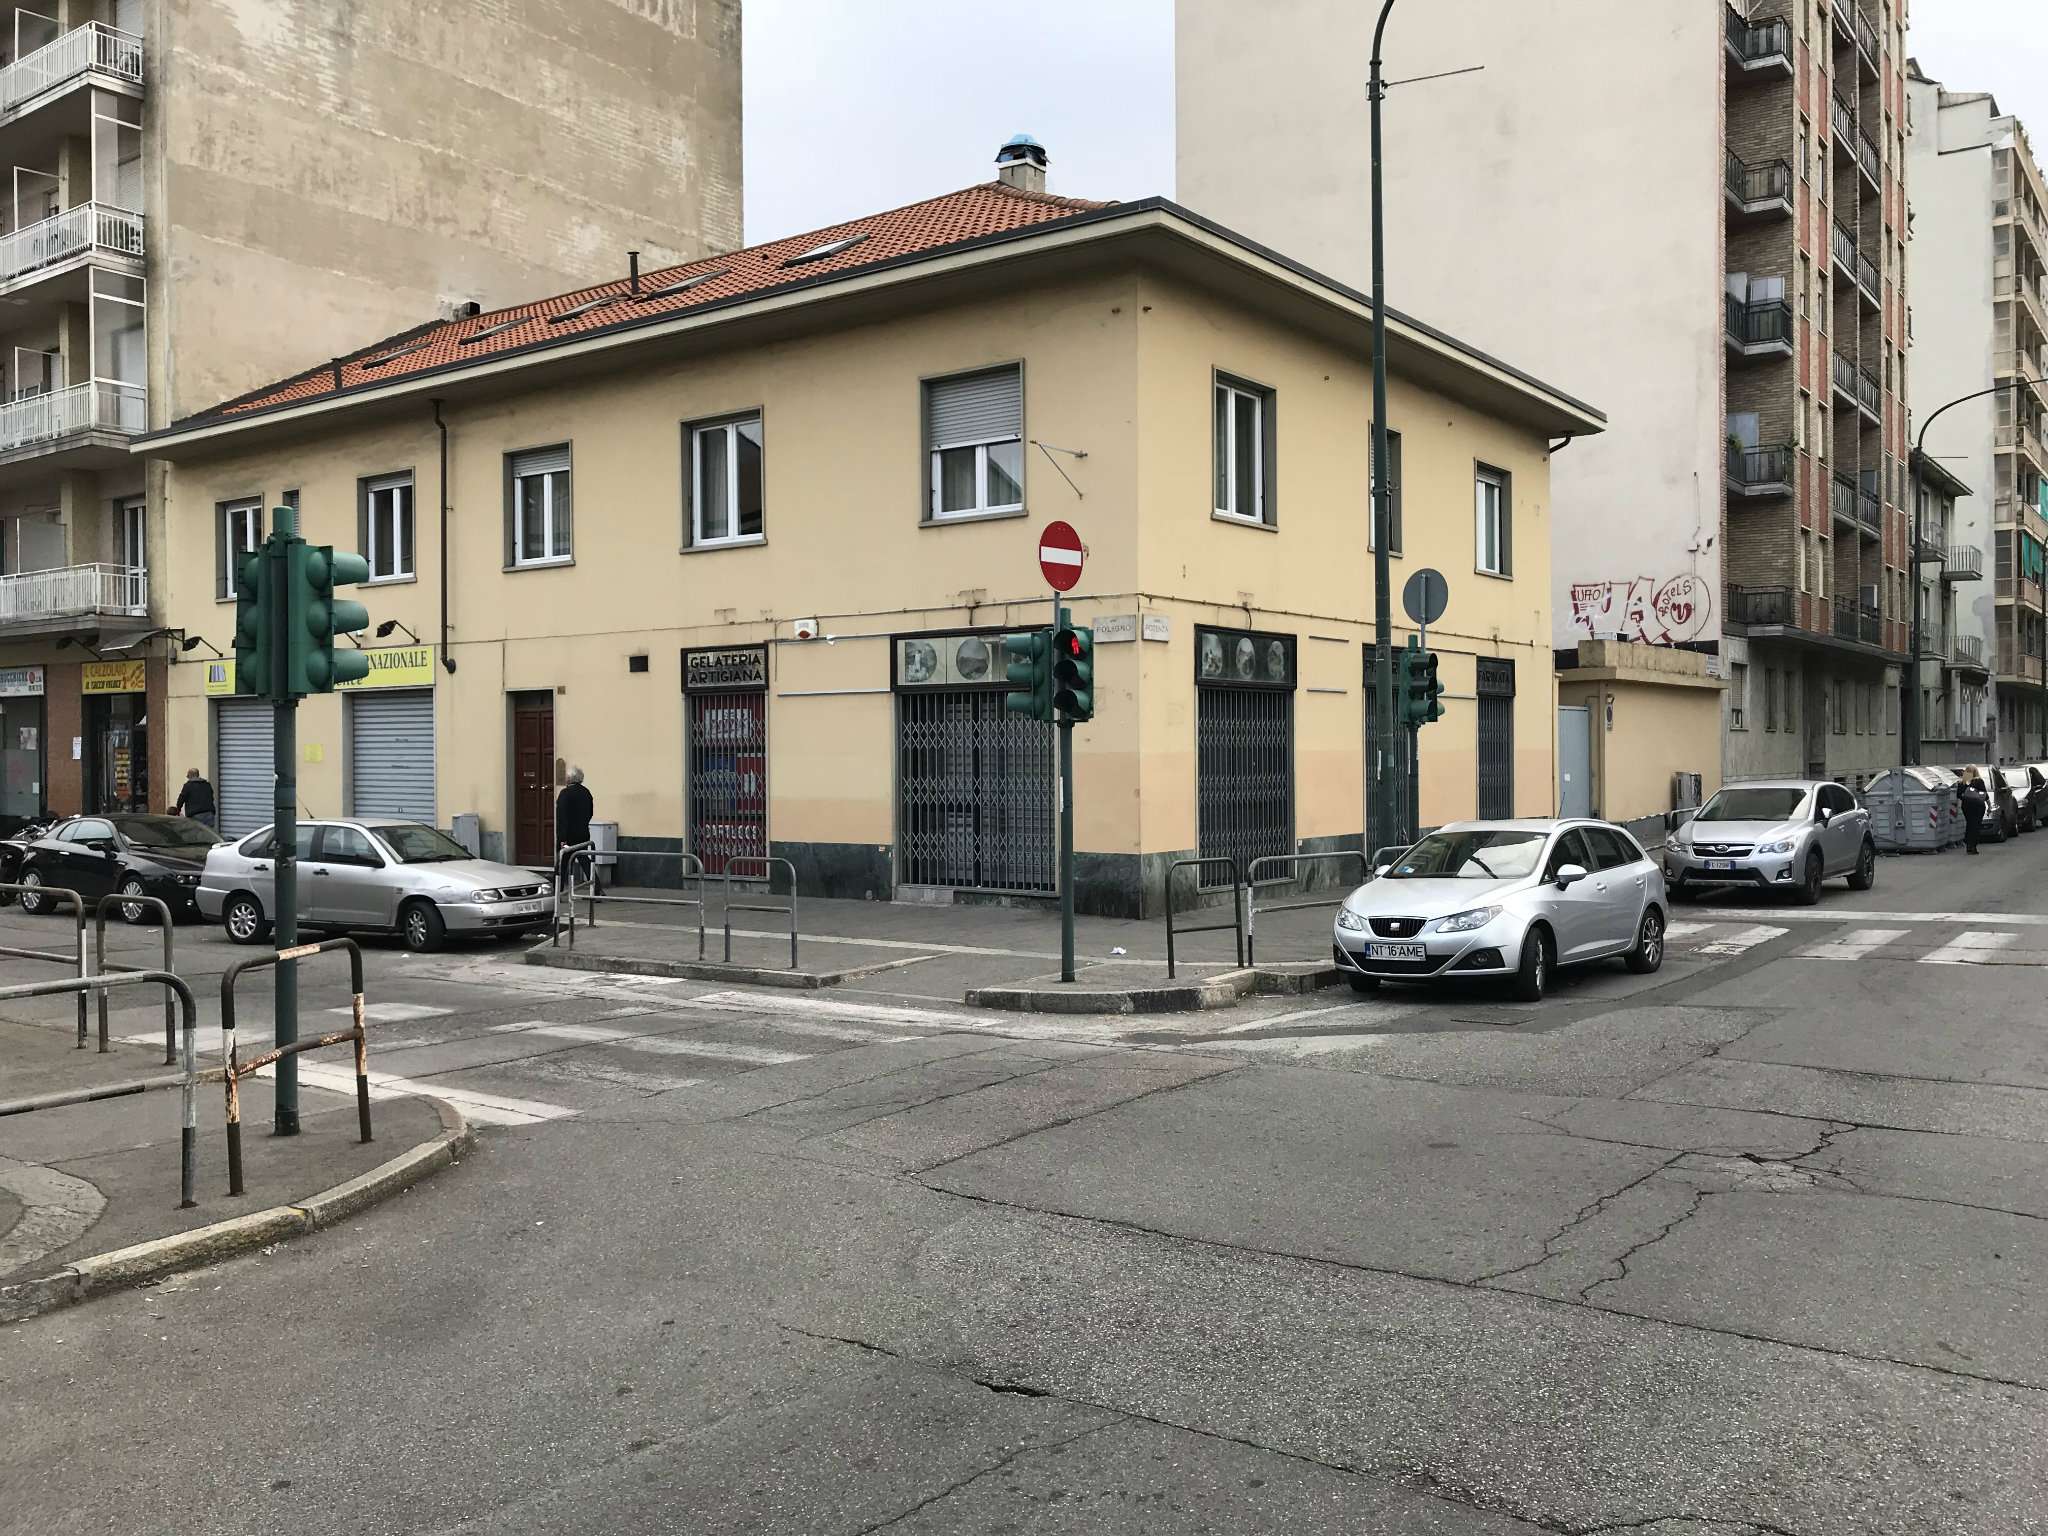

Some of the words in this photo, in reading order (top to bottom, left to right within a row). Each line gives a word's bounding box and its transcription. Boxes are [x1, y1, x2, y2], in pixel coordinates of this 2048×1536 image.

[691, 653, 761, 668] GELATERIA
[689, 669, 763, 683] ARTIGIANA
[1371, 945, 1384, 956] NT
[1387, 945, 1397, 957] 16
[1399, 945, 1424, 958] AME
